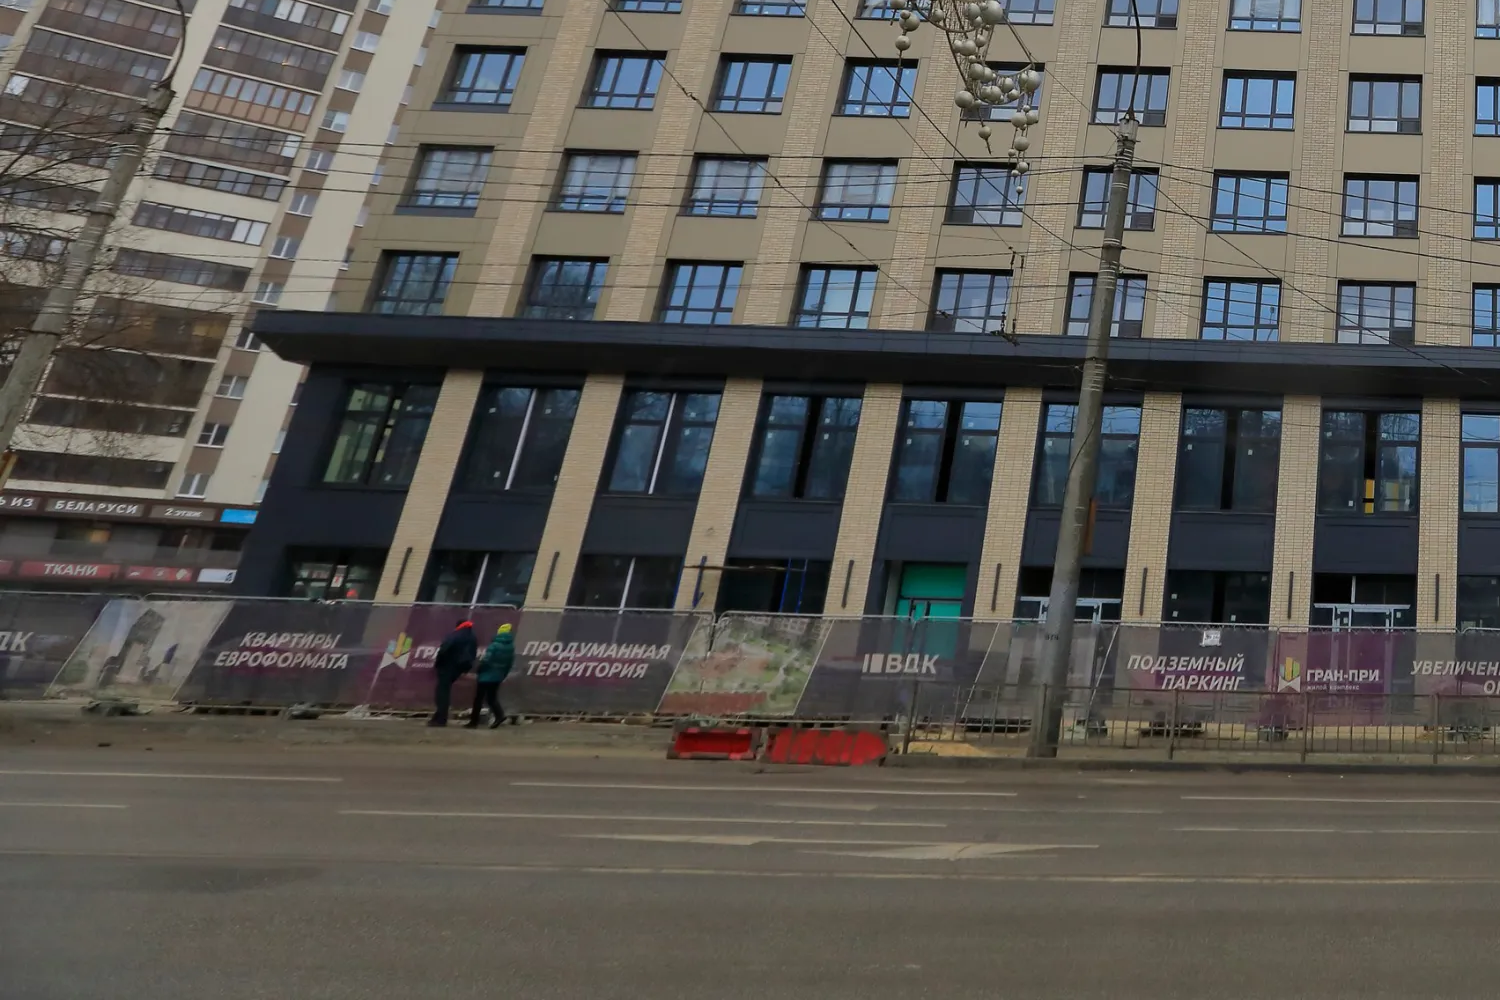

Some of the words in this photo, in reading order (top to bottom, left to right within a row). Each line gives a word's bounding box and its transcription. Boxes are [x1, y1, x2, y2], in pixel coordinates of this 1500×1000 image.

[10, 497, 34, 508] ИЗ
[54, 499, 138, 514] БЕЛАРУСИ
[164, 508, 172, 516] 2
[43, 563, 99, 577] ТКАНИ
[239, 631, 342, 650] КВАРТИРЫ
[522, 640, 672, 660] ПРОДУМАННАЯ
[214, 650, 350, 670] ЕВРОФОРМАТА
[526, 660, 650, 679] ТЕРРИТОРИЯ
[885, 653, 940, 674] ВДК
[1127, 653, 1245, 673] ПОДЗЕМНЫЙ
[1161, 675, 1245, 691] ПАРКИНГ
[1306, 669, 1380, 682] ГРАН-ПРИ
